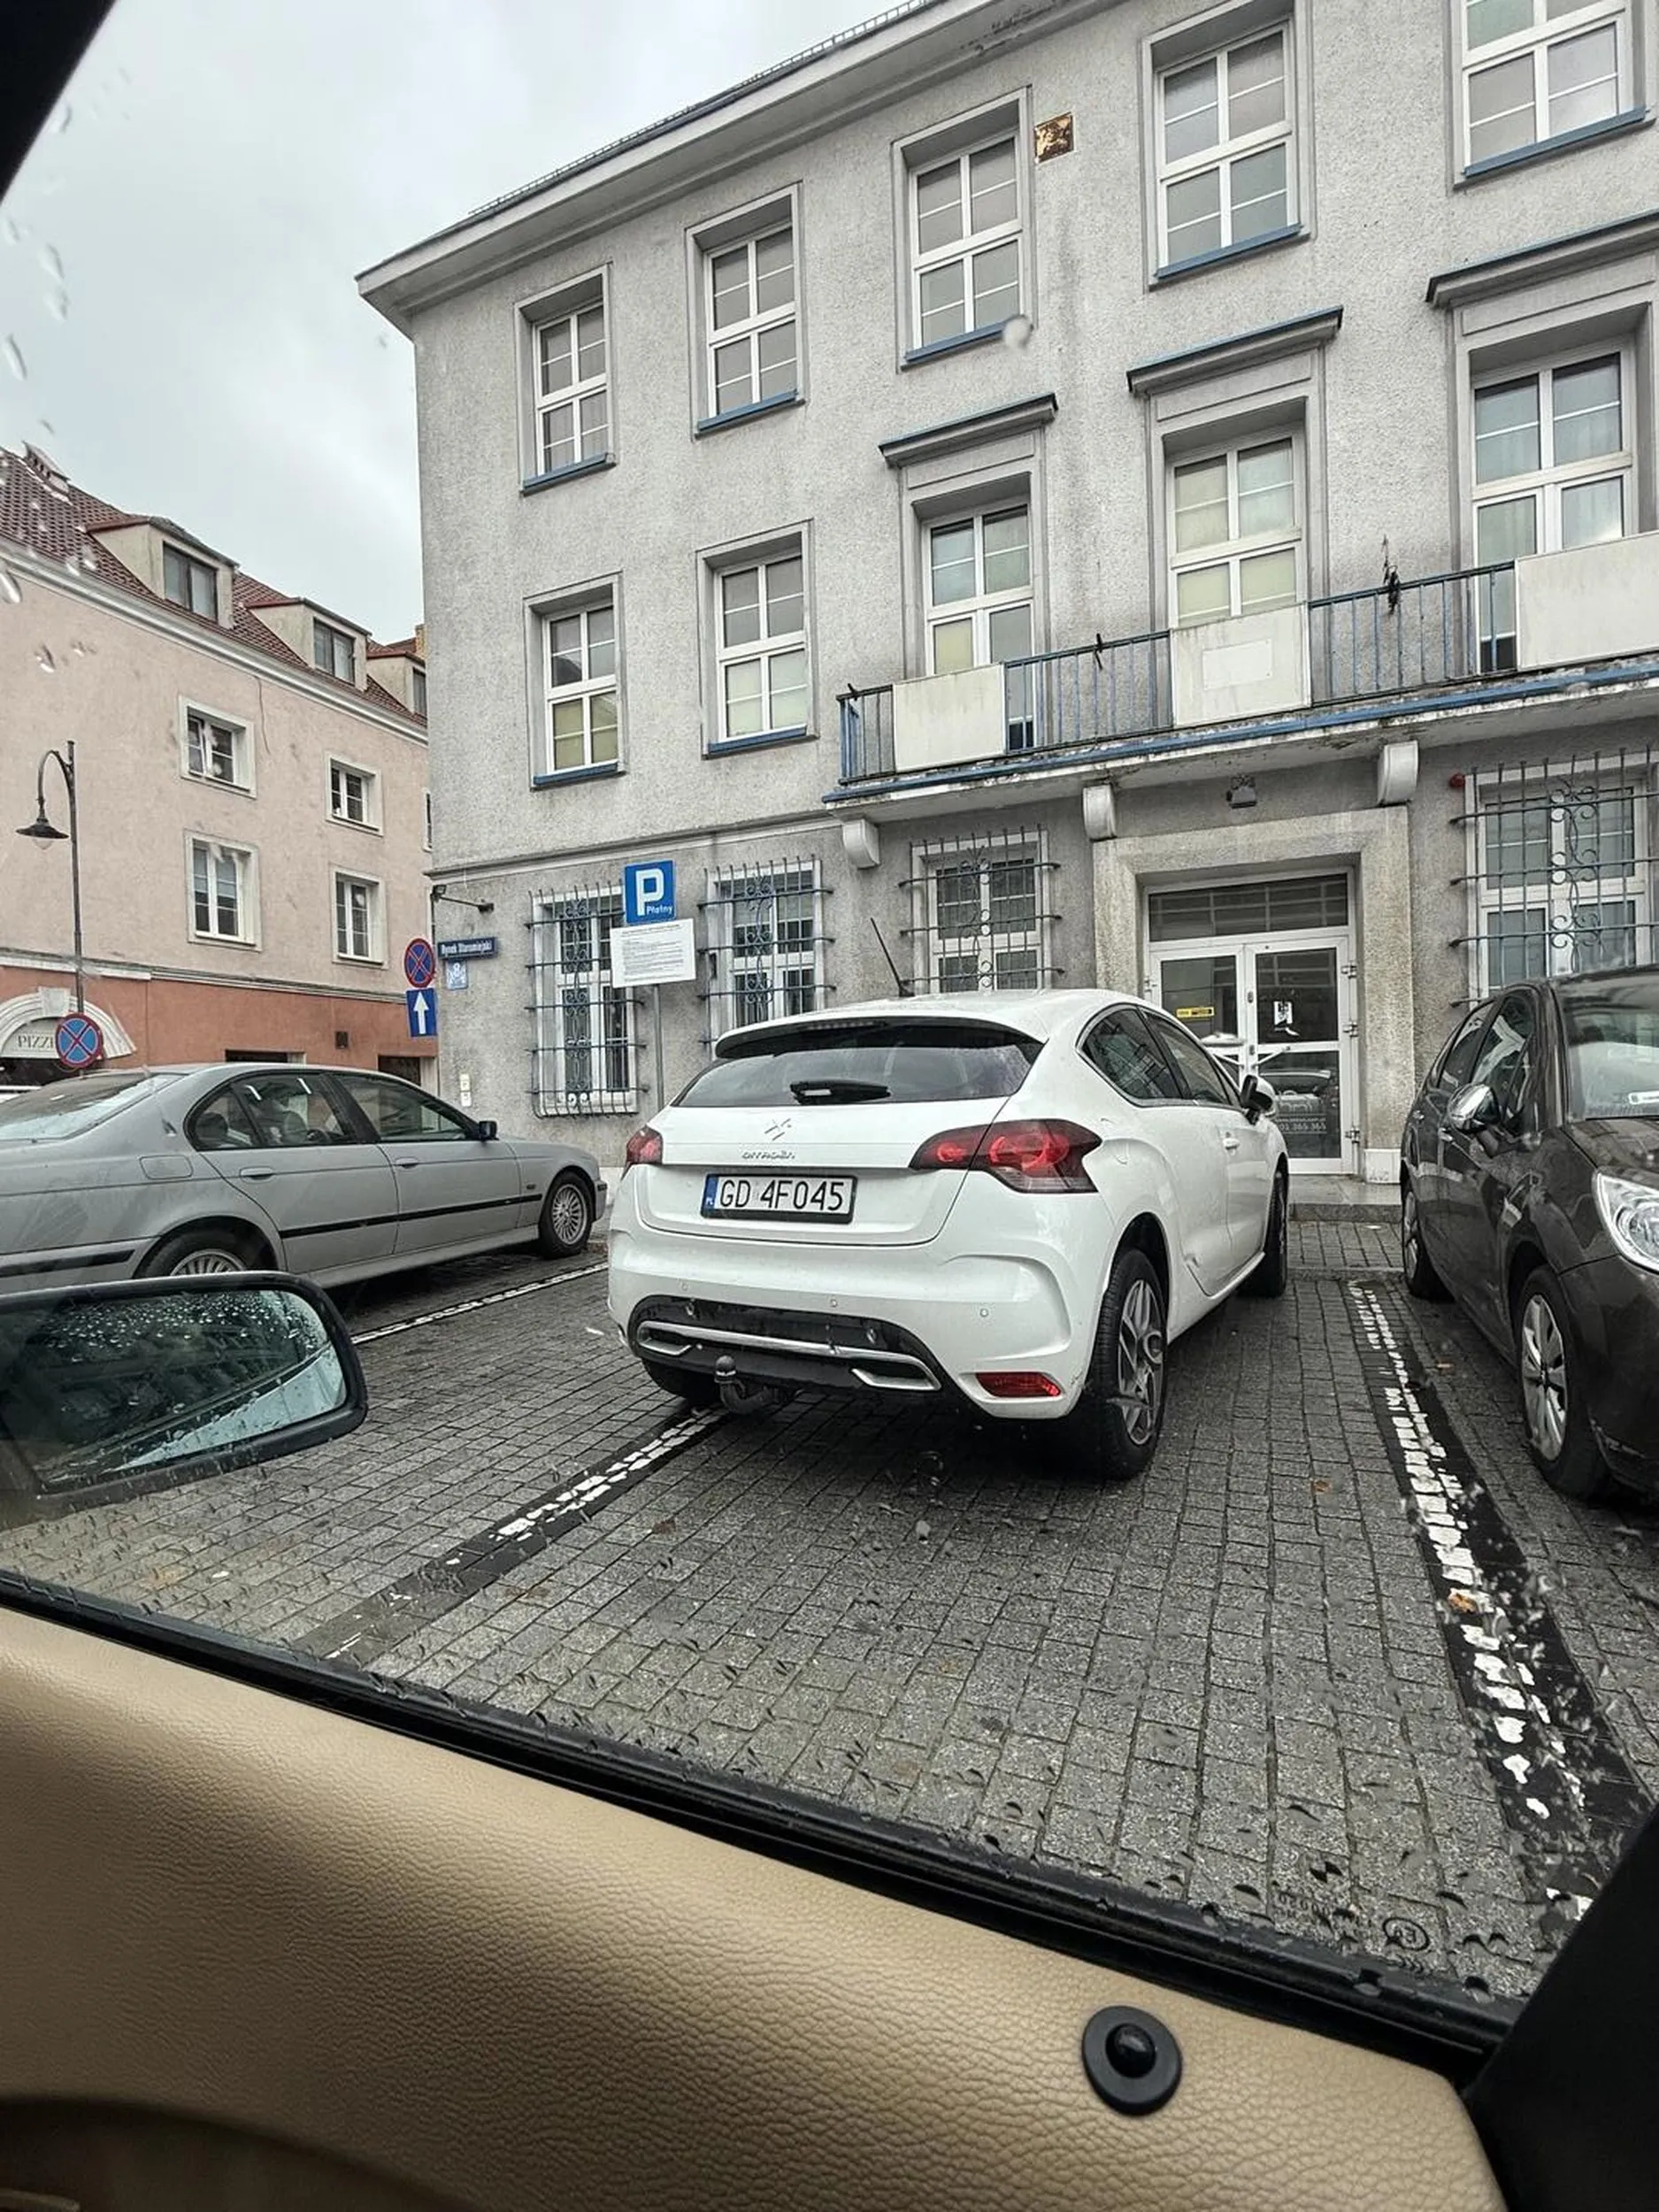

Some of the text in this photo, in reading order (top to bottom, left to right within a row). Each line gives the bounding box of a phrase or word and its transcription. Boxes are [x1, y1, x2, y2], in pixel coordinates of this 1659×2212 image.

[636, 868, 664, 916] P
[646, 904, 673, 915] Płatny
[719, 1179, 844, 1210] GD 4F045
